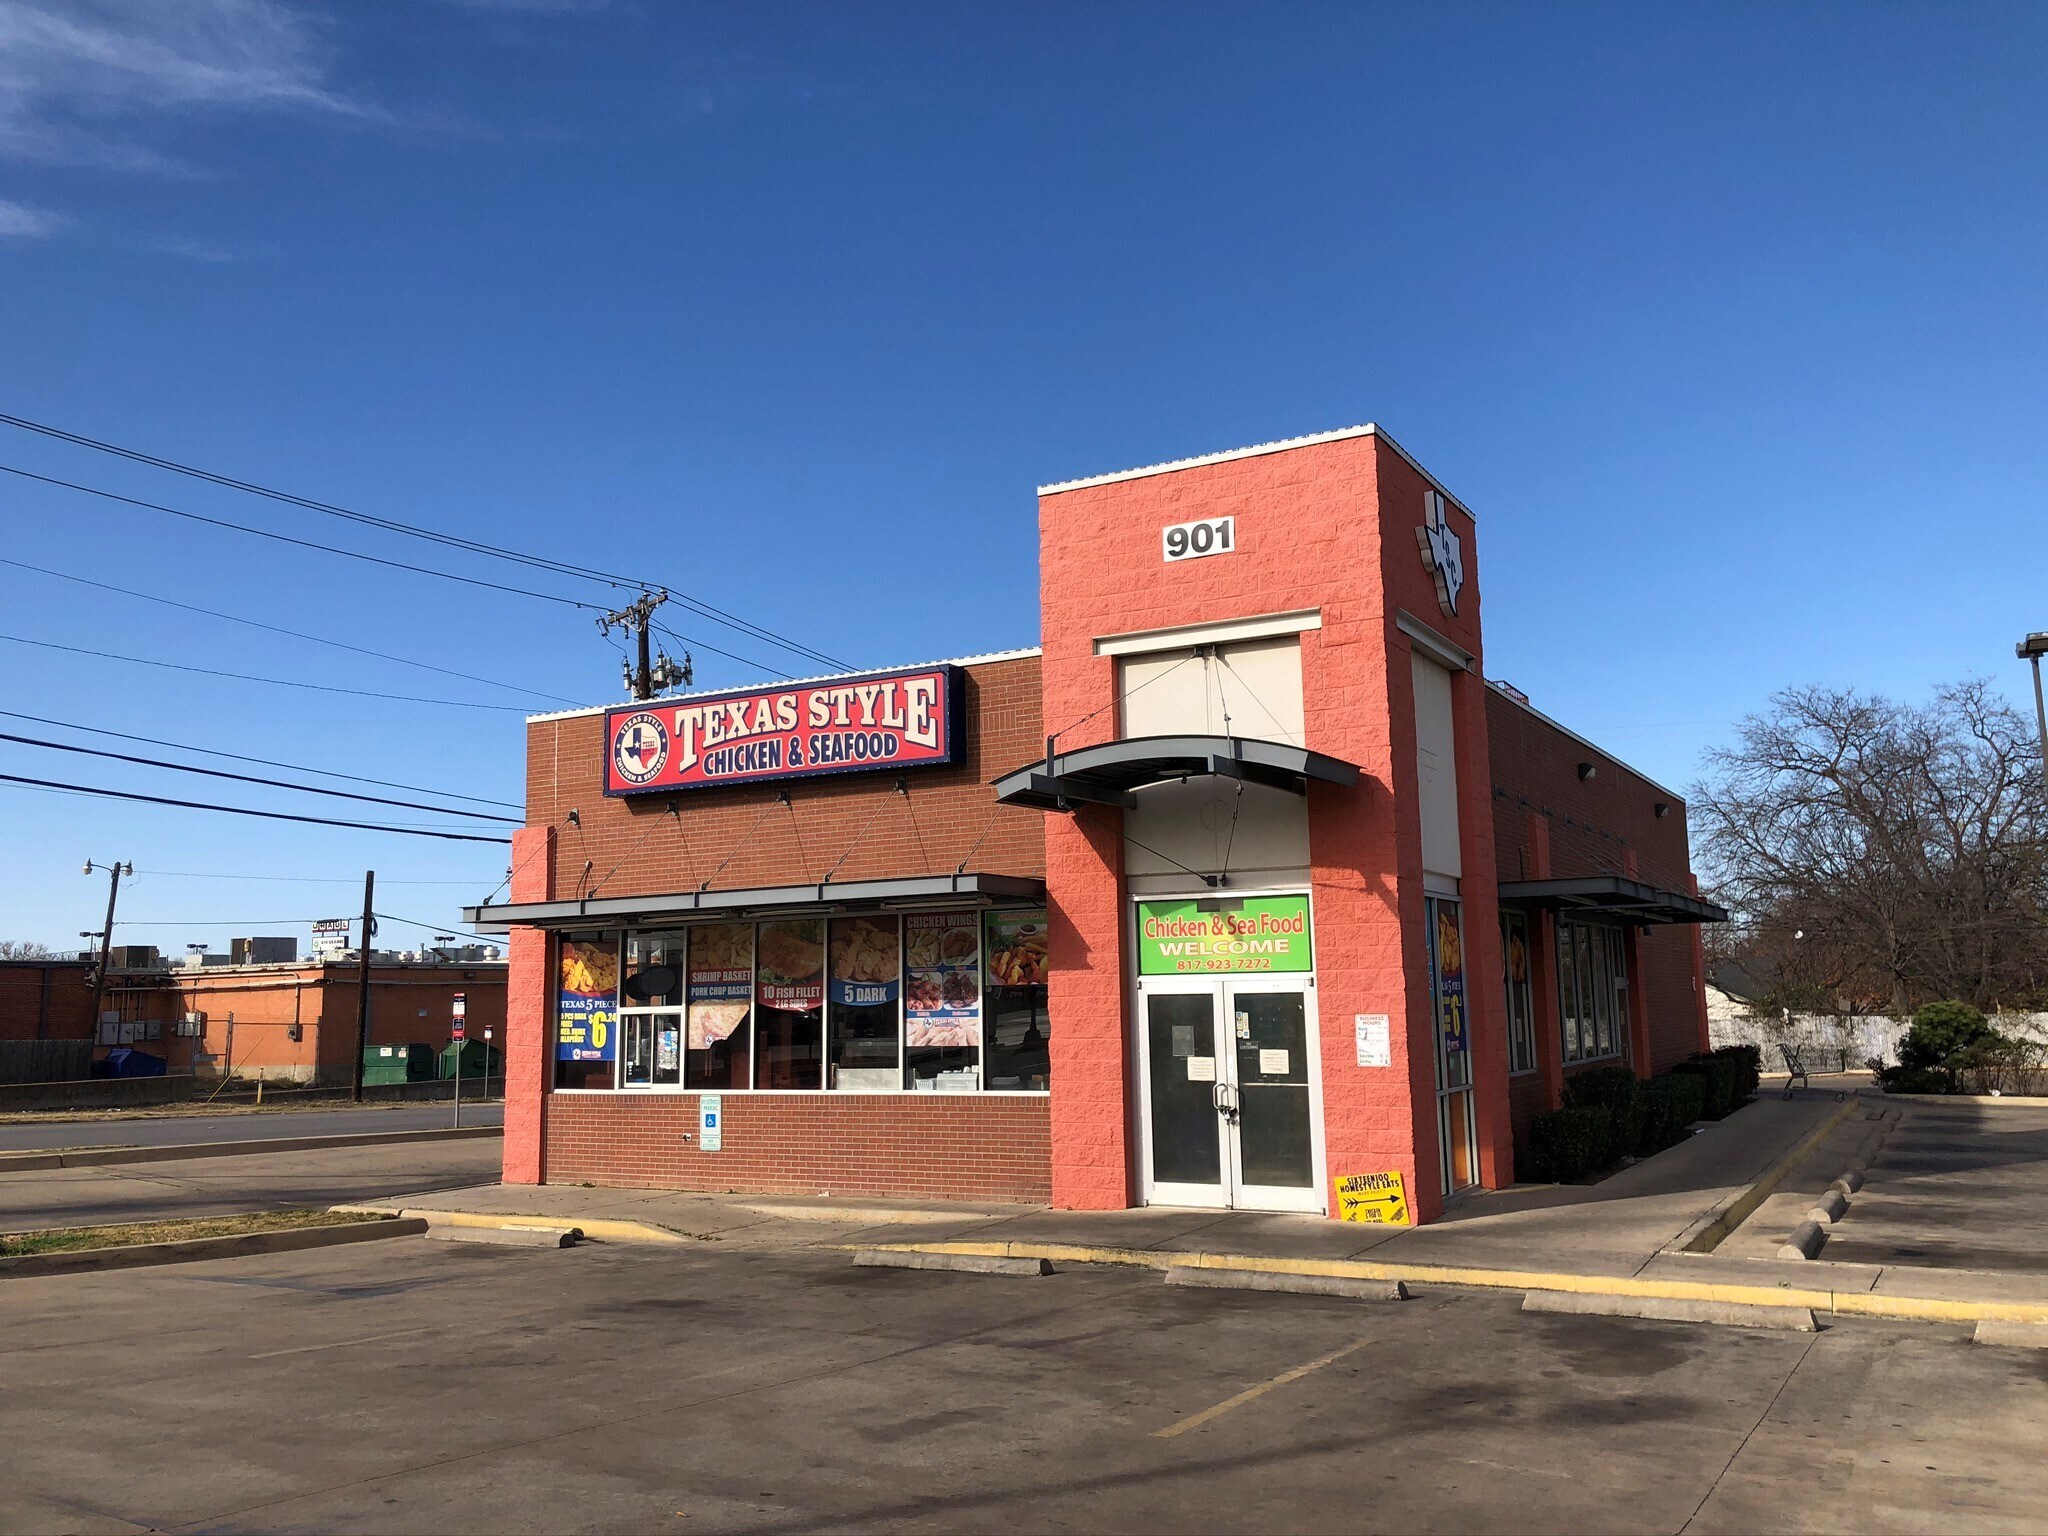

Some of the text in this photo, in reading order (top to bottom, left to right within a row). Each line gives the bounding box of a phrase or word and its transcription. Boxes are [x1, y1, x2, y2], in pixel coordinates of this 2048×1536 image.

[1166, 519, 1230, 558] 901
[620, 715, 664, 735] TEXAS STYLE
[674, 677, 939, 774] TEXAS STYLE
[702, 731, 899, 777] CHICKEN & SEAFOOD
[616, 756, 637, 782] CHICKEN
[643, 751, 667, 781] SEAFOOD
[907, 913, 978, 929] CHICKEN WINGS
[1144, 910, 1304, 939] Chicken & Sea Food
[1158, 938, 1290, 957] WELCOME
[1176, 958, 1271, 971] 817-923-7272
[692, 970, 751, 983] SHRIMP BASKET
[691, 985, 751, 997] PORK CHOP BASKET
[763, 985, 821, 999] 10 FISH FILLET
[844, 985, 888, 1003] 5 DARK
[561, 999, 617, 1011] TEXAS 5 PIECE
[775, 998, 808, 1009] 2 LG SIDES
[1340, 1181, 1380, 1193] HOMESTYLE
[1383, 1180, 1399, 1188] EATS
